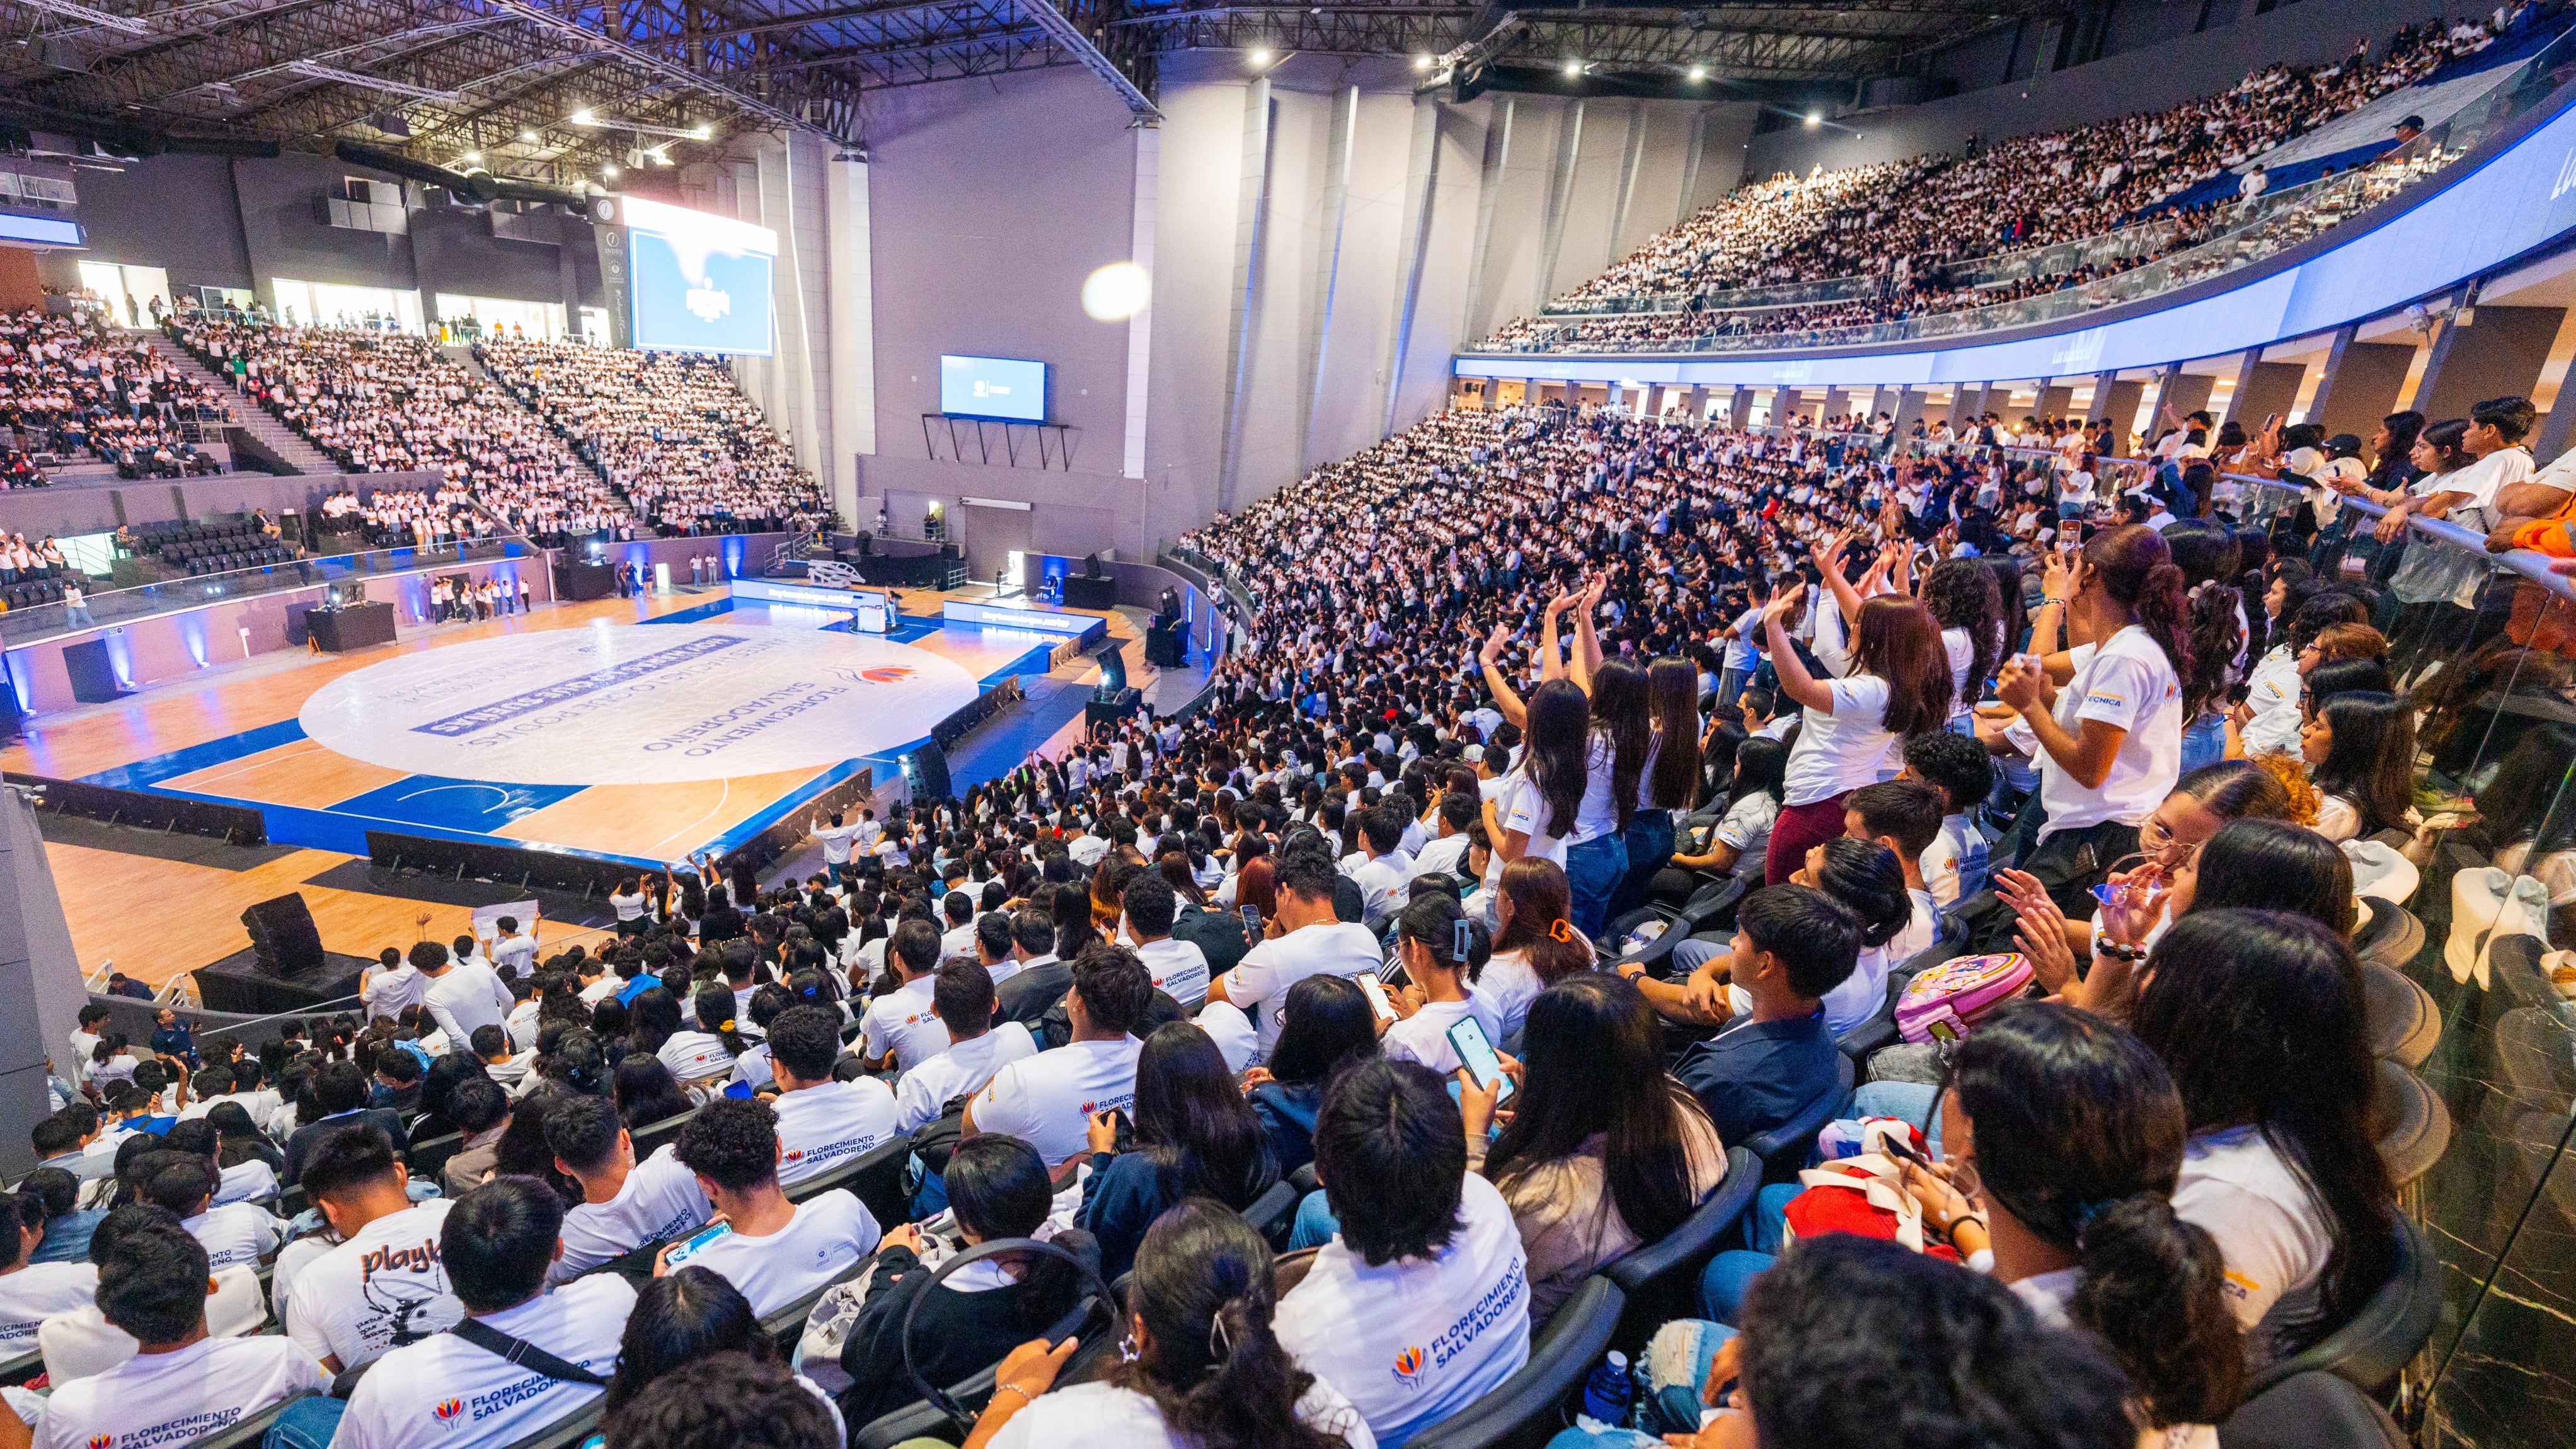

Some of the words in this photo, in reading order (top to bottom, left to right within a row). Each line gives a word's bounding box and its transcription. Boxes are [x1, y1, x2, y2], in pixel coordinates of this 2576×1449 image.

[531, 680, 602, 699] QUE
[630, 680, 670, 692] LO
[572, 692, 633, 711] QUE
[423, 696, 551, 733] SUEÑAS
[643, 682, 815, 752] SALVADOREÑO
[684, 686, 849, 756] FLORECIMIENTO
[1166, 964, 1205, 982] FLORECIMIENTO
[1166, 968, 1206, 988] SALVADOREÑO
[922, 1016, 936, 1024] SAL
[807, 1135, 875, 1157] FLORECIMIENTO
[807, 1142, 875, 1164] SALVADOREÑO
[1431, 1257, 1520, 1354] FLORECIMIENTO
[0, 1319, 45, 1332] ECIMIEN
[121, 1407, 241, 1444] FLORECIMIENTO
